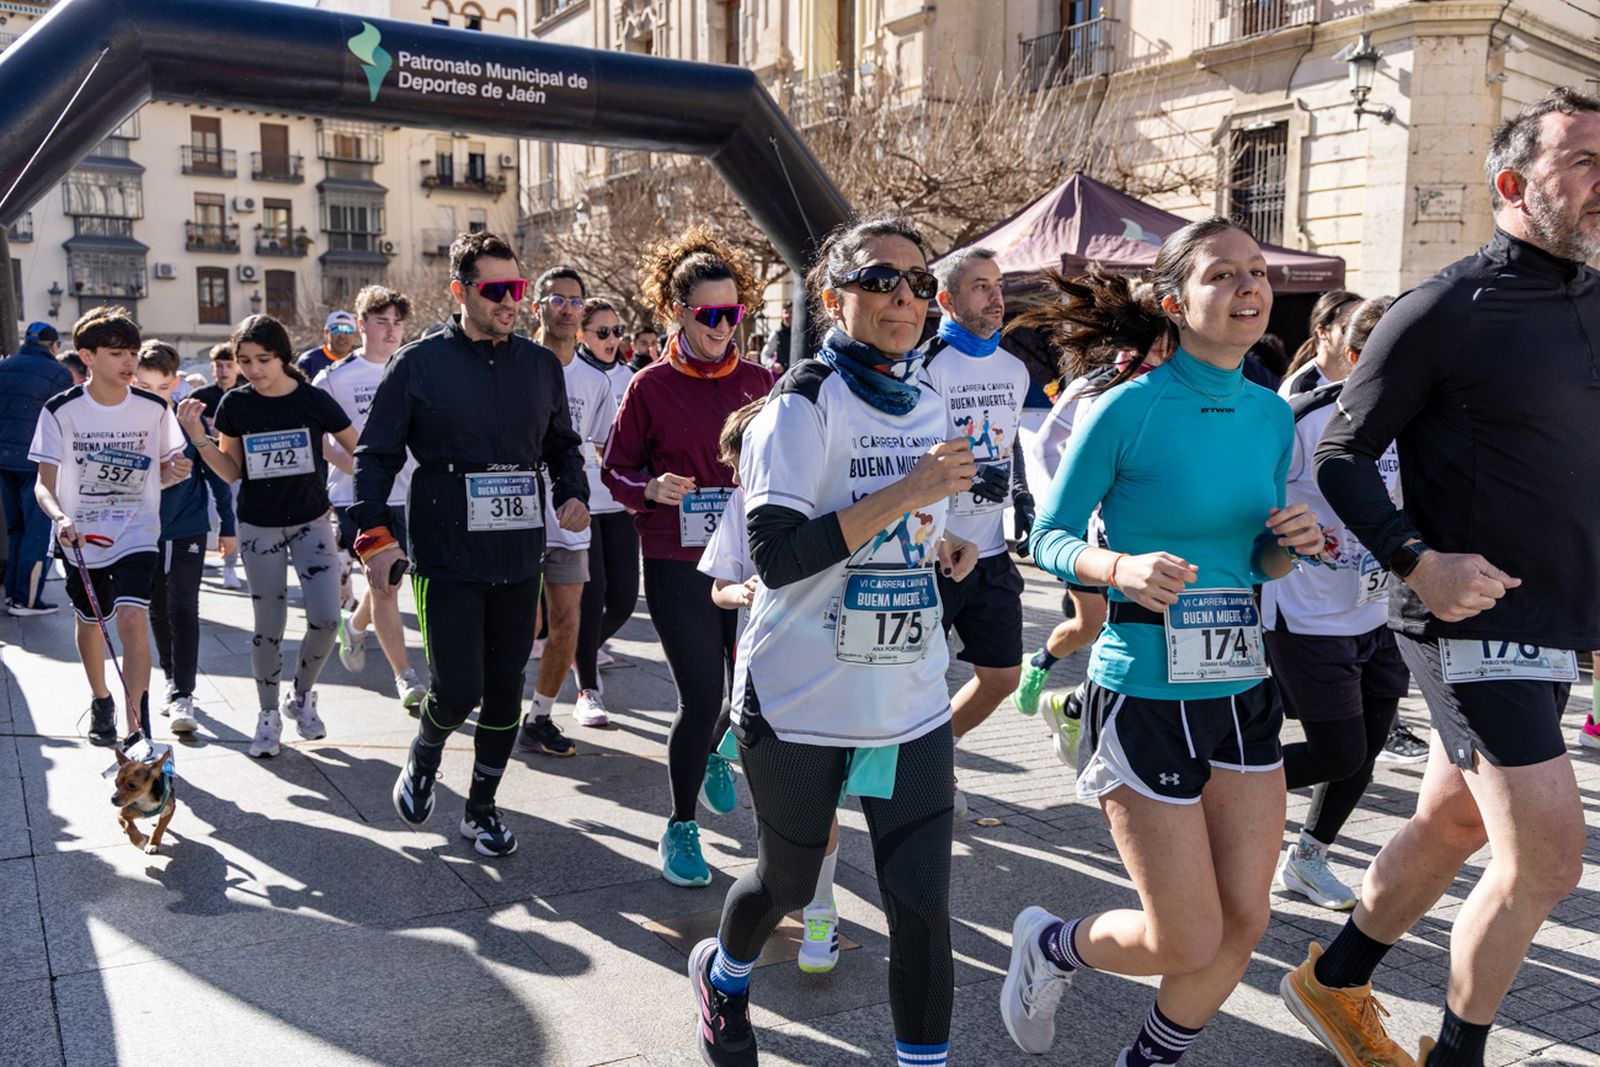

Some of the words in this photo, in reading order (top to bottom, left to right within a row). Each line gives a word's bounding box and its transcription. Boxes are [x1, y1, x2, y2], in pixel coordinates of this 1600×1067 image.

[398, 51, 481, 77] Patronato
[486, 62, 563, 88] Municipal
[567, 73, 588, 89] de
[399, 71, 476, 94] Deportes
[481, 81, 503, 99] de
[506, 86, 546, 104] Jaén
[957, 385, 986, 393] CARRERA
[987, 382, 1014, 391] CAMINATA
[950, 396, 976, 410] BUENA
[977, 394, 1007, 407] MUERTE
[73, 441, 100, 451] BUENA
[860, 435, 905, 448] CARRERA
[262, 449, 297, 468] 742
[850, 456, 895, 478] BUENA
[97, 464, 133, 482] 557
[491, 497, 523, 518] 318
[860, 579, 868, 588] VI
[869, 580, 905, 589] CARRERA
[857, 592, 890, 607] BUENA
[893, 591, 920, 606] MUERTE
[1183, 599, 1191, 607] VI
[1192, 598, 1227, 606] CARRERA
[1183, 611, 1214, 624] BUENA
[1217, 609, 1241, 623] MUERTE
[876, 611, 922, 645] 175
[1201, 628, 1248, 660] 174
